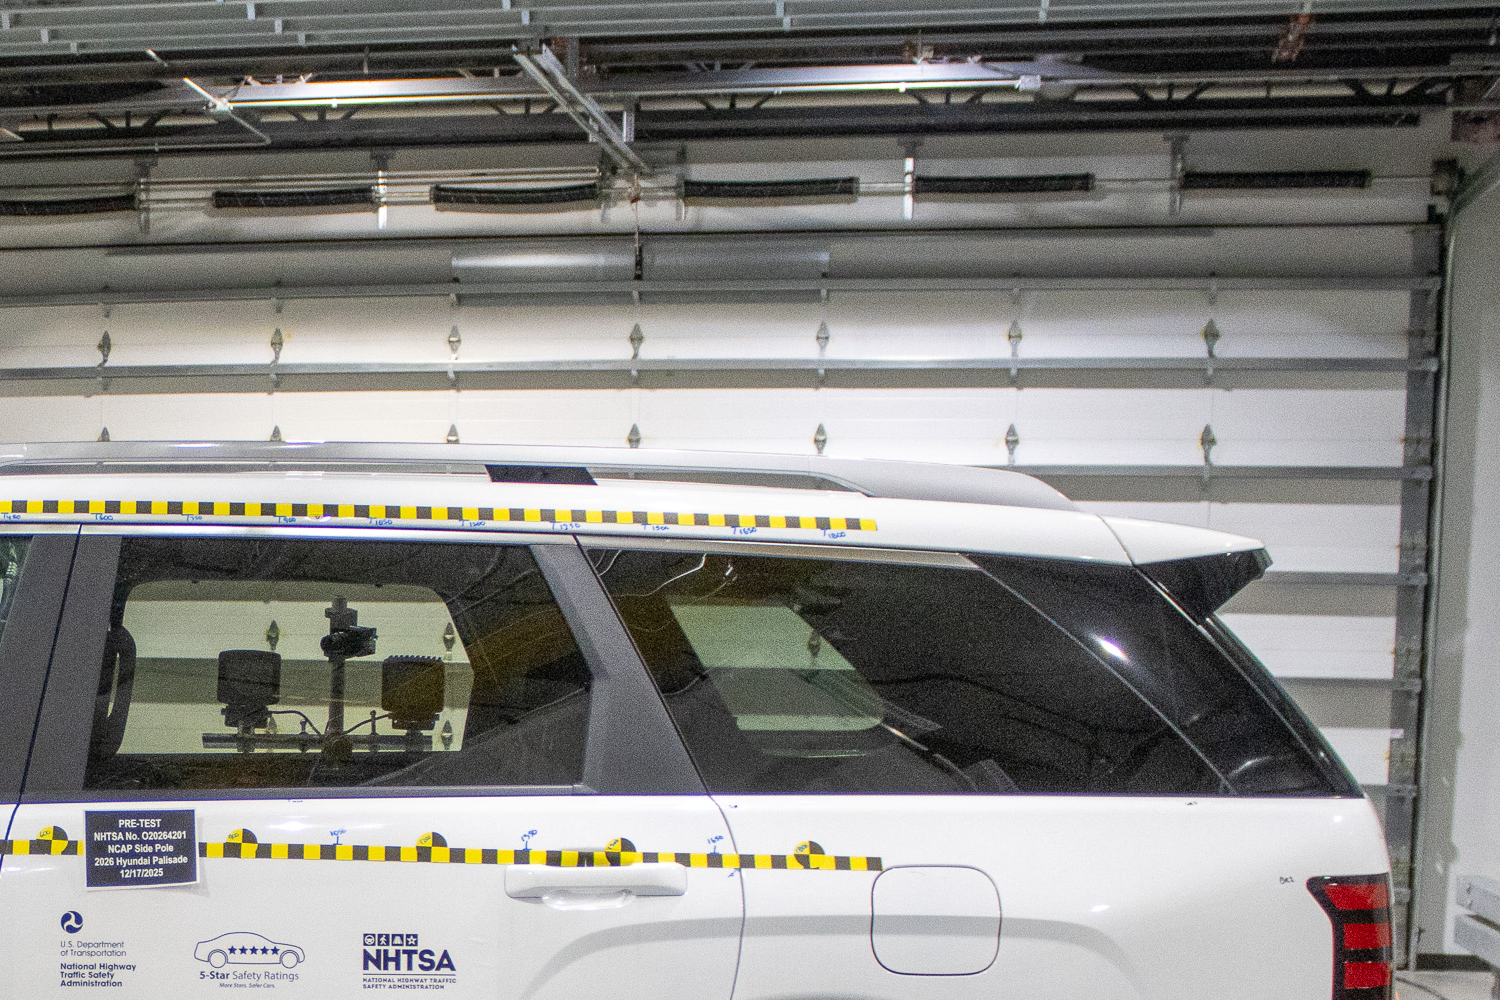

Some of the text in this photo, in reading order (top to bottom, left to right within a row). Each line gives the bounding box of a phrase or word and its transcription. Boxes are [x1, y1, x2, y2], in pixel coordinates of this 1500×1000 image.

[118, 819, 161, 828] PRE-TEST
[94, 831, 186, 841] NHTSA No. O20264201
[108, 844, 174, 853] NCAP Side Pole
[94, 855, 188, 867] 2026 Hyundai Palisade
[120, 868, 164, 878] 12/17/2025
[77, 940, 124, 950] Department
[69, 950, 127, 958] Transportation
[363, 949, 456, 971] NHTSA
[60, 963, 136, 972] National Highway
[60, 971, 115, 980] Traffic Safety
[199, 971, 300, 982] 5-Star Safety Ratings
